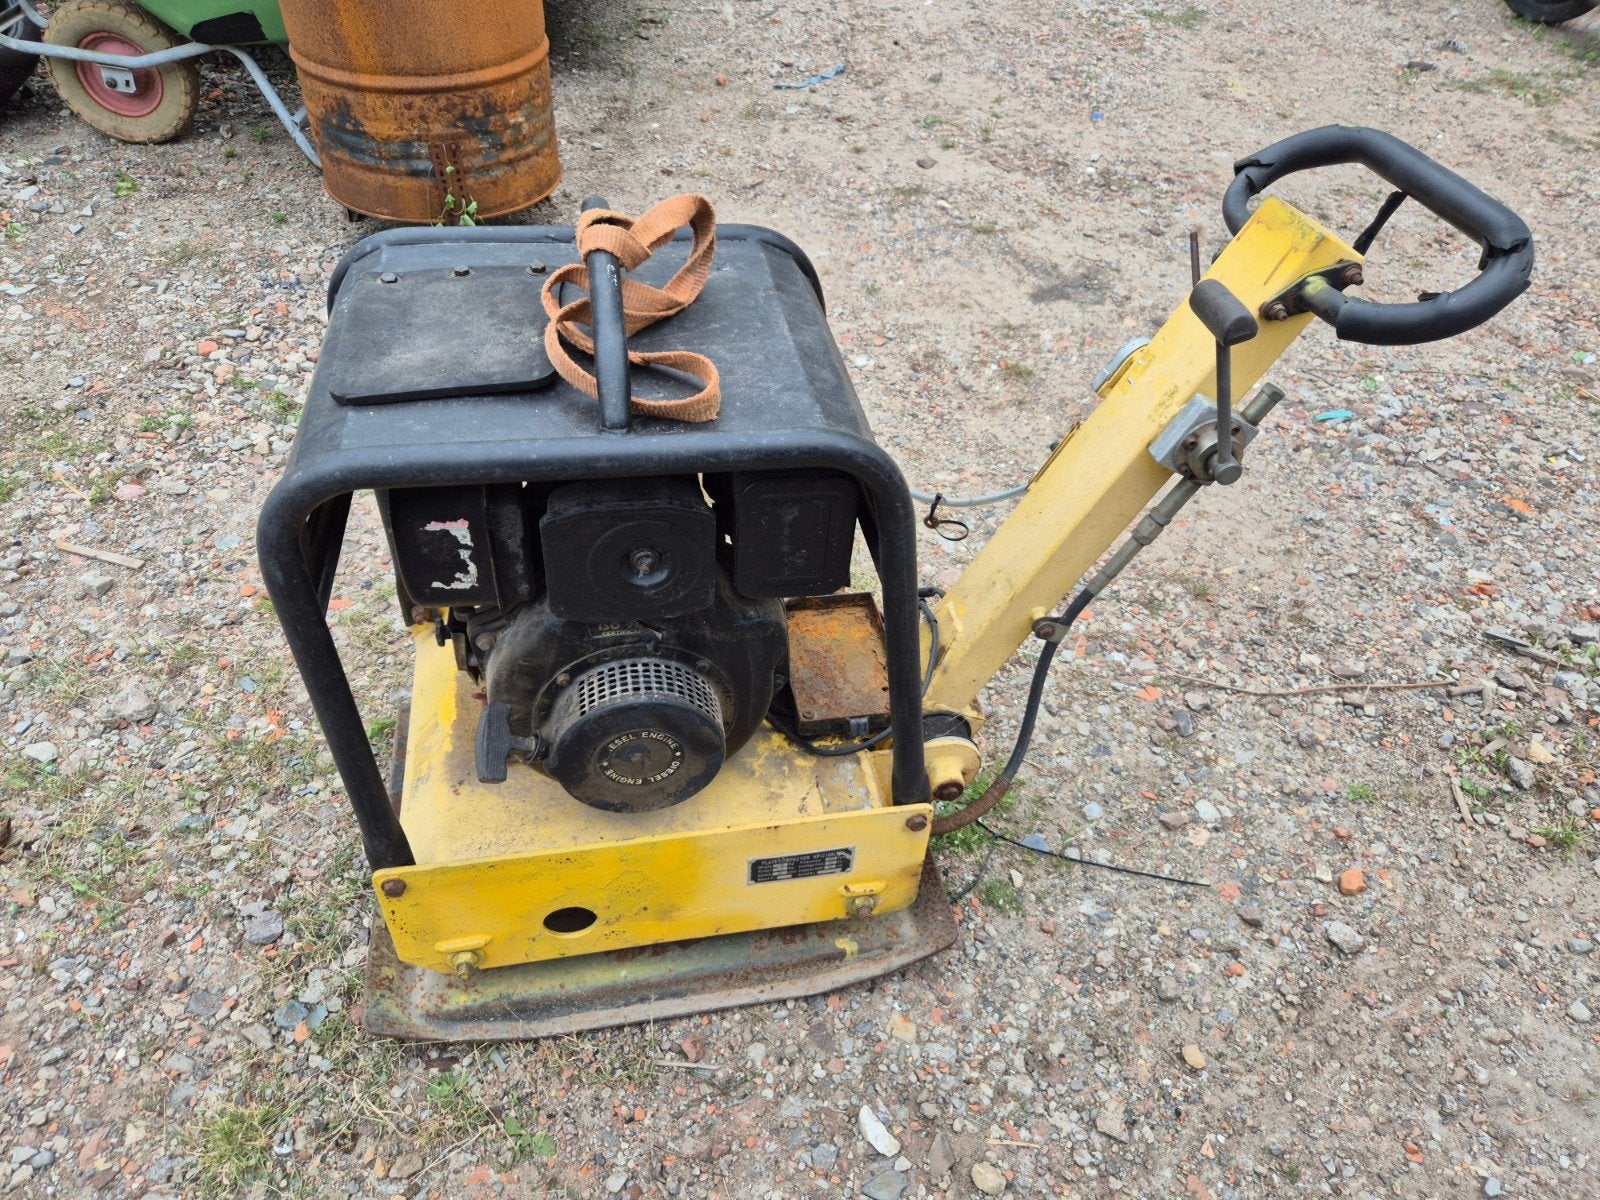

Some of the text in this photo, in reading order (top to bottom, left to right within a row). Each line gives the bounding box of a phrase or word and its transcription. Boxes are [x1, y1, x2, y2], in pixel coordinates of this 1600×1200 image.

[608, 731, 680, 752] ESEL ENGINE
[604, 761, 680, 785] DIESEL ENGINE
